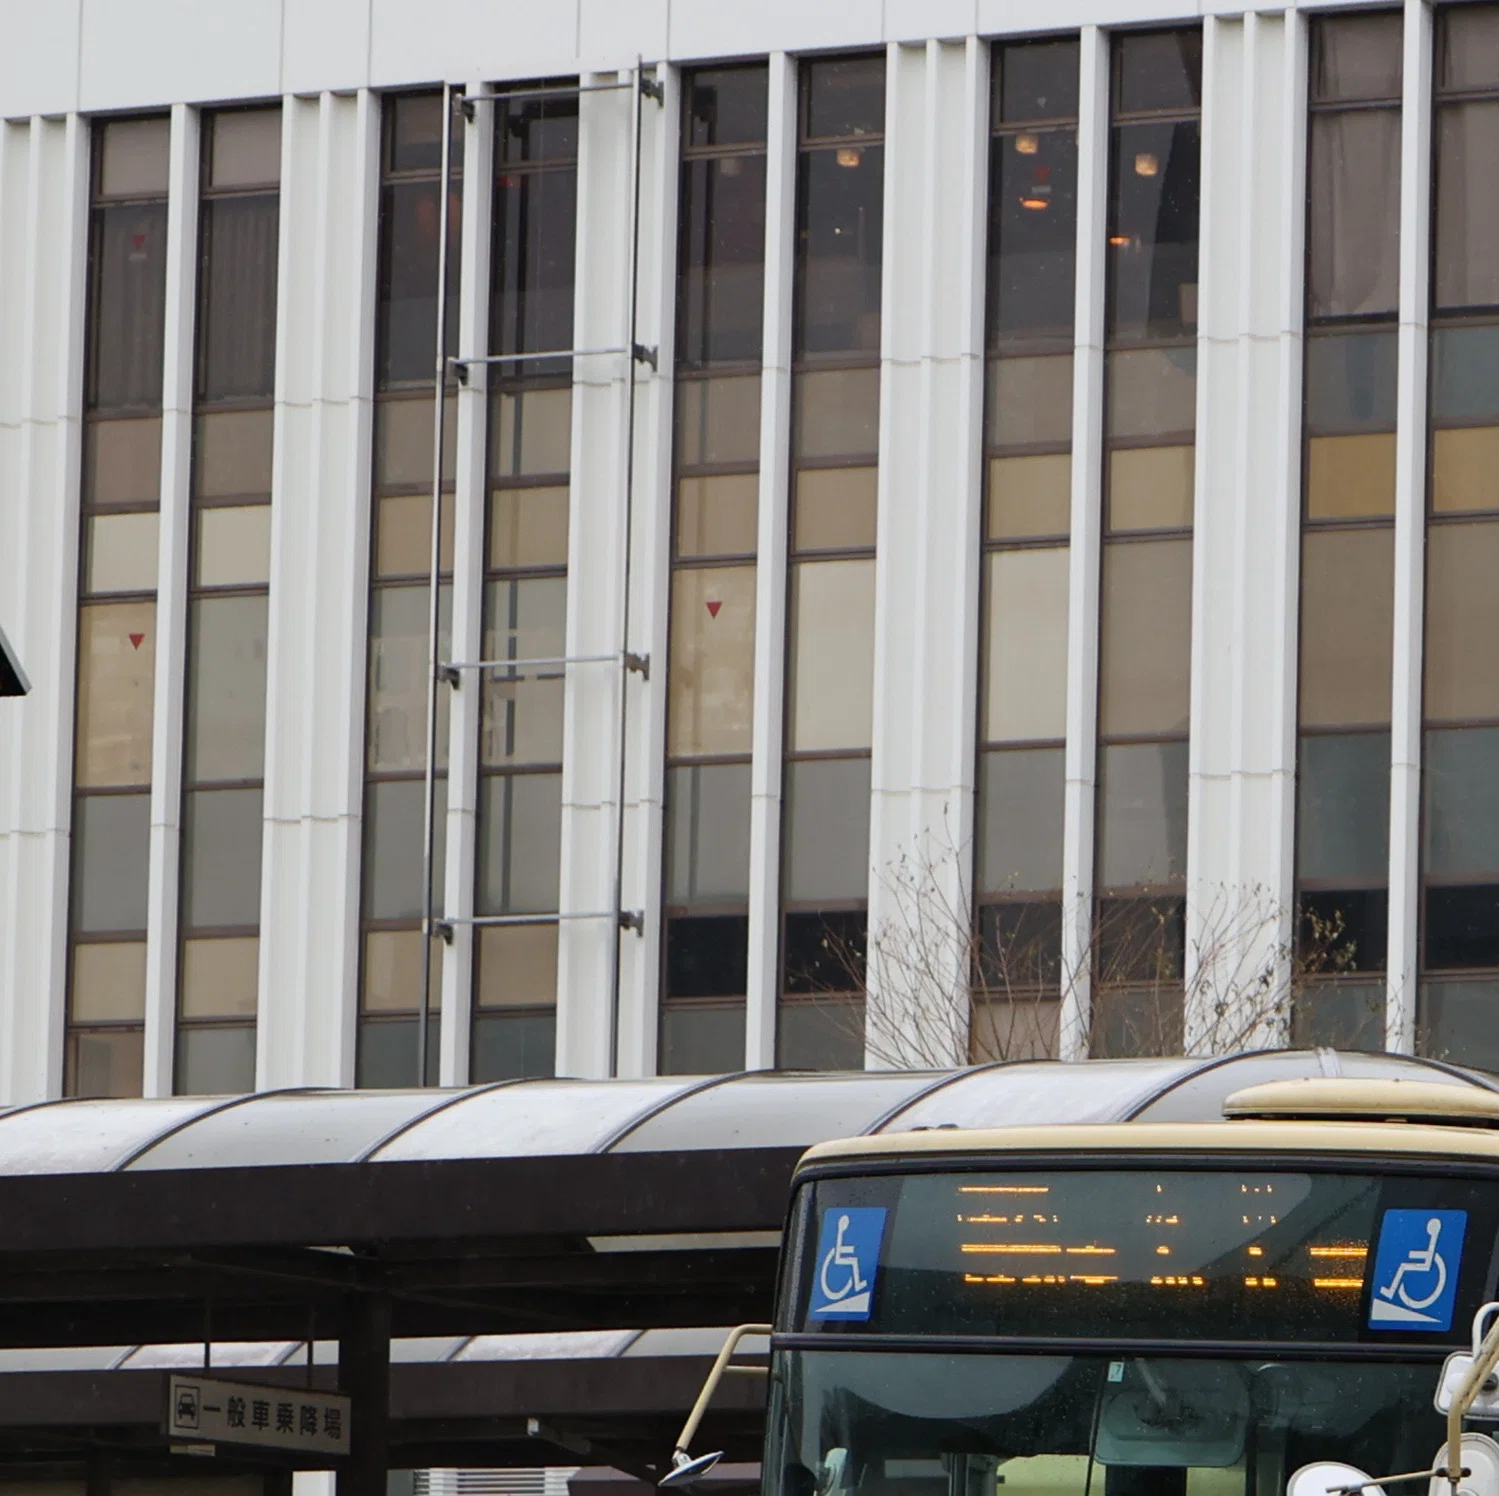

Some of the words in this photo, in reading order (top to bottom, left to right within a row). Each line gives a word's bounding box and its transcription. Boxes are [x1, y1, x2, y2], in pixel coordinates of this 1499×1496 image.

[203, 1396, 342, 1440] 一般車乗降場
